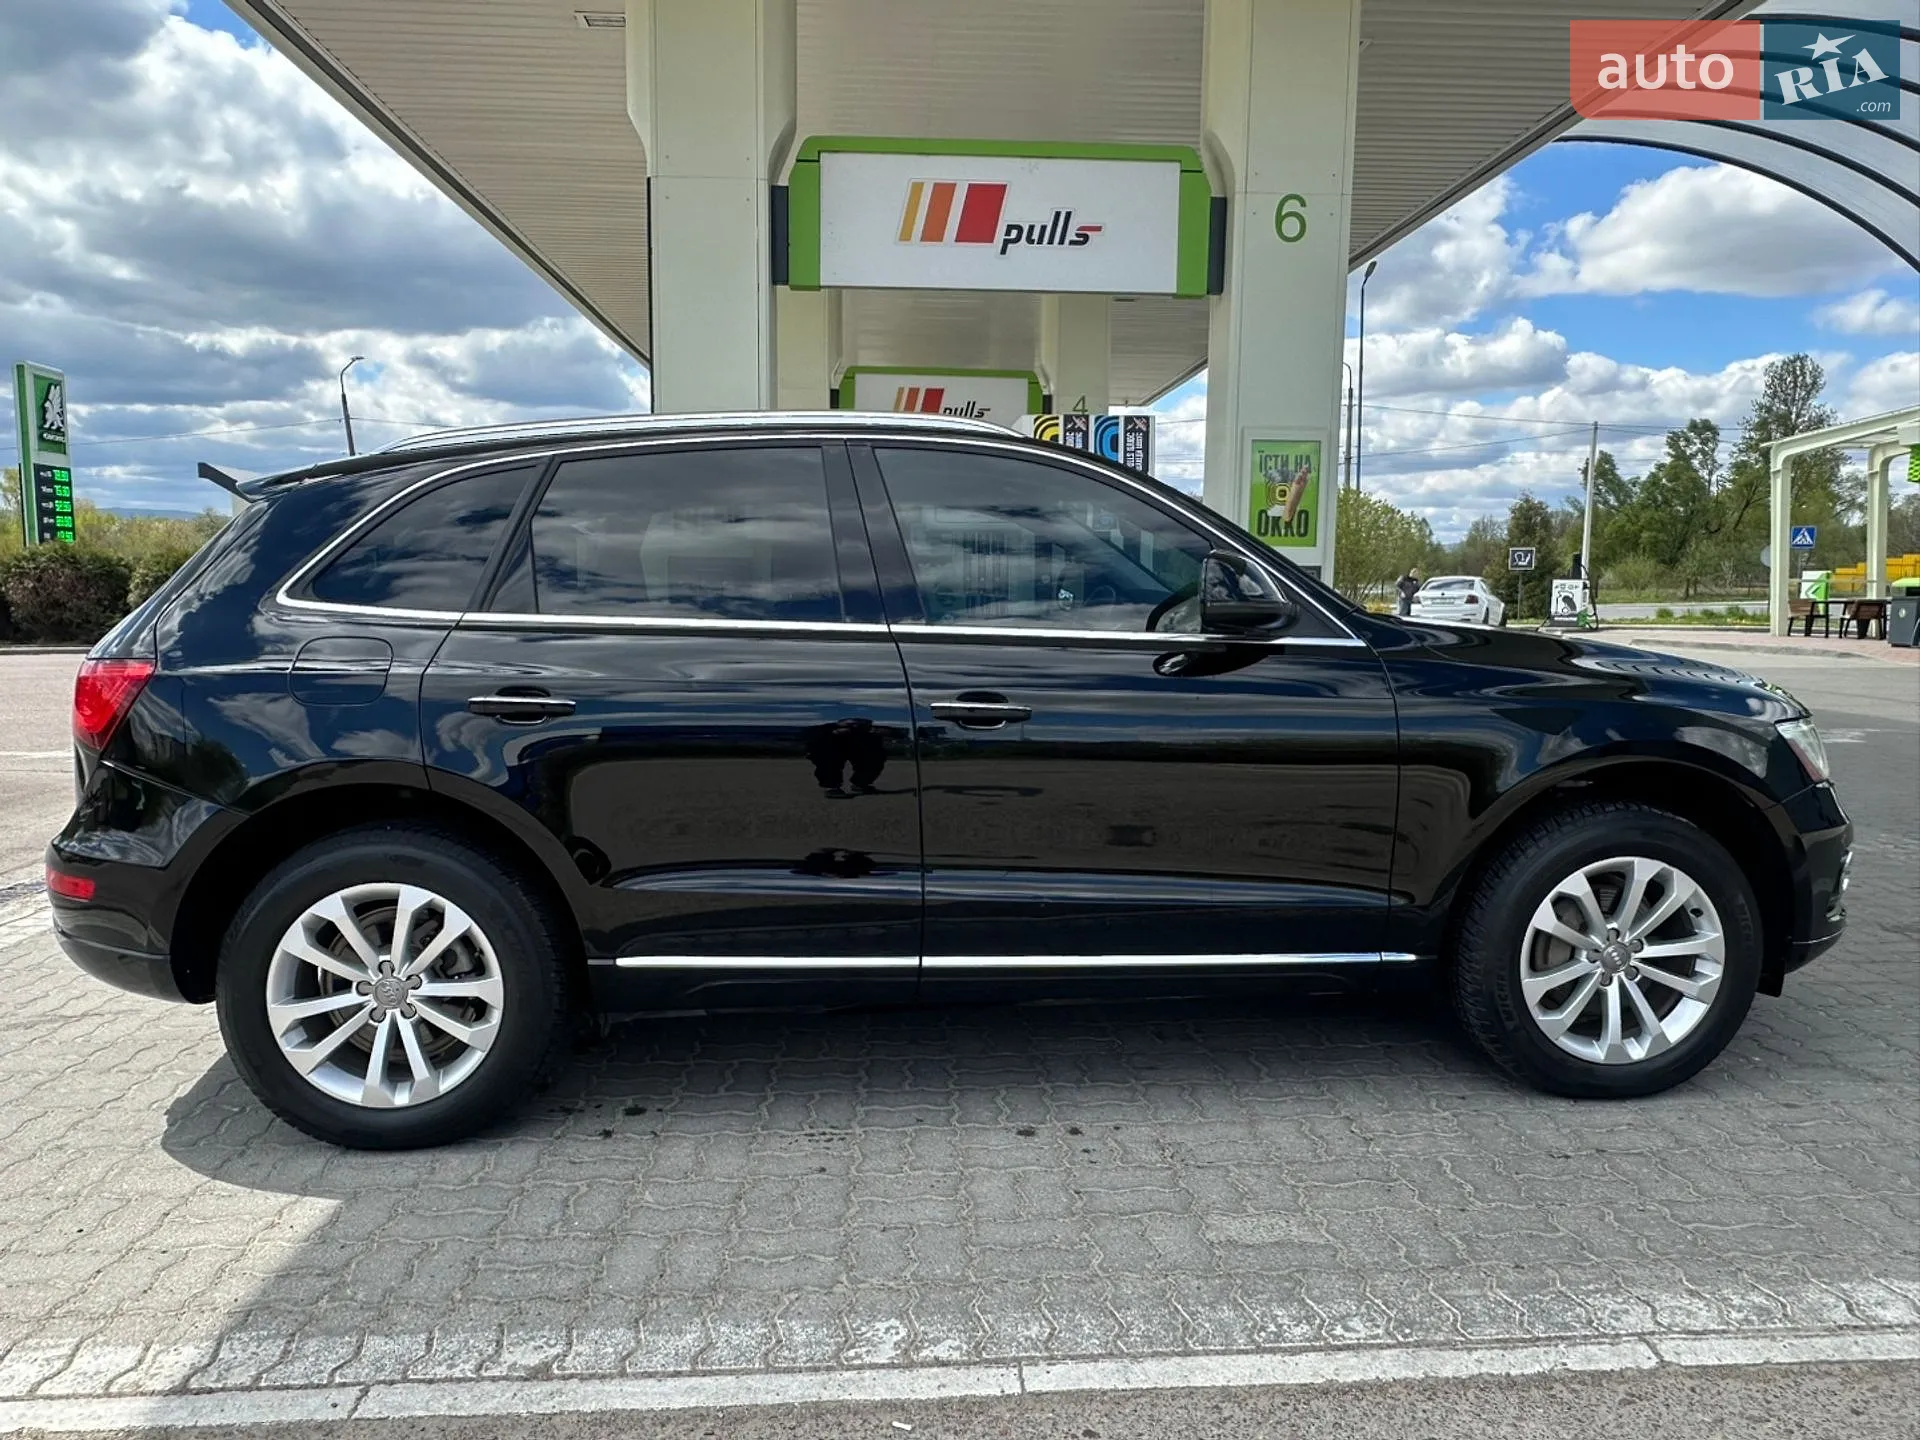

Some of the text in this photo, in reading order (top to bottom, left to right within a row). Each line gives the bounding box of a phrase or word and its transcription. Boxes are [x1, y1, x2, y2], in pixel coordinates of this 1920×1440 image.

[999, 210, 1103, 256] pulls
[1274, 193, 1307, 243] 6
[1071, 395, 1089, 415] 4
